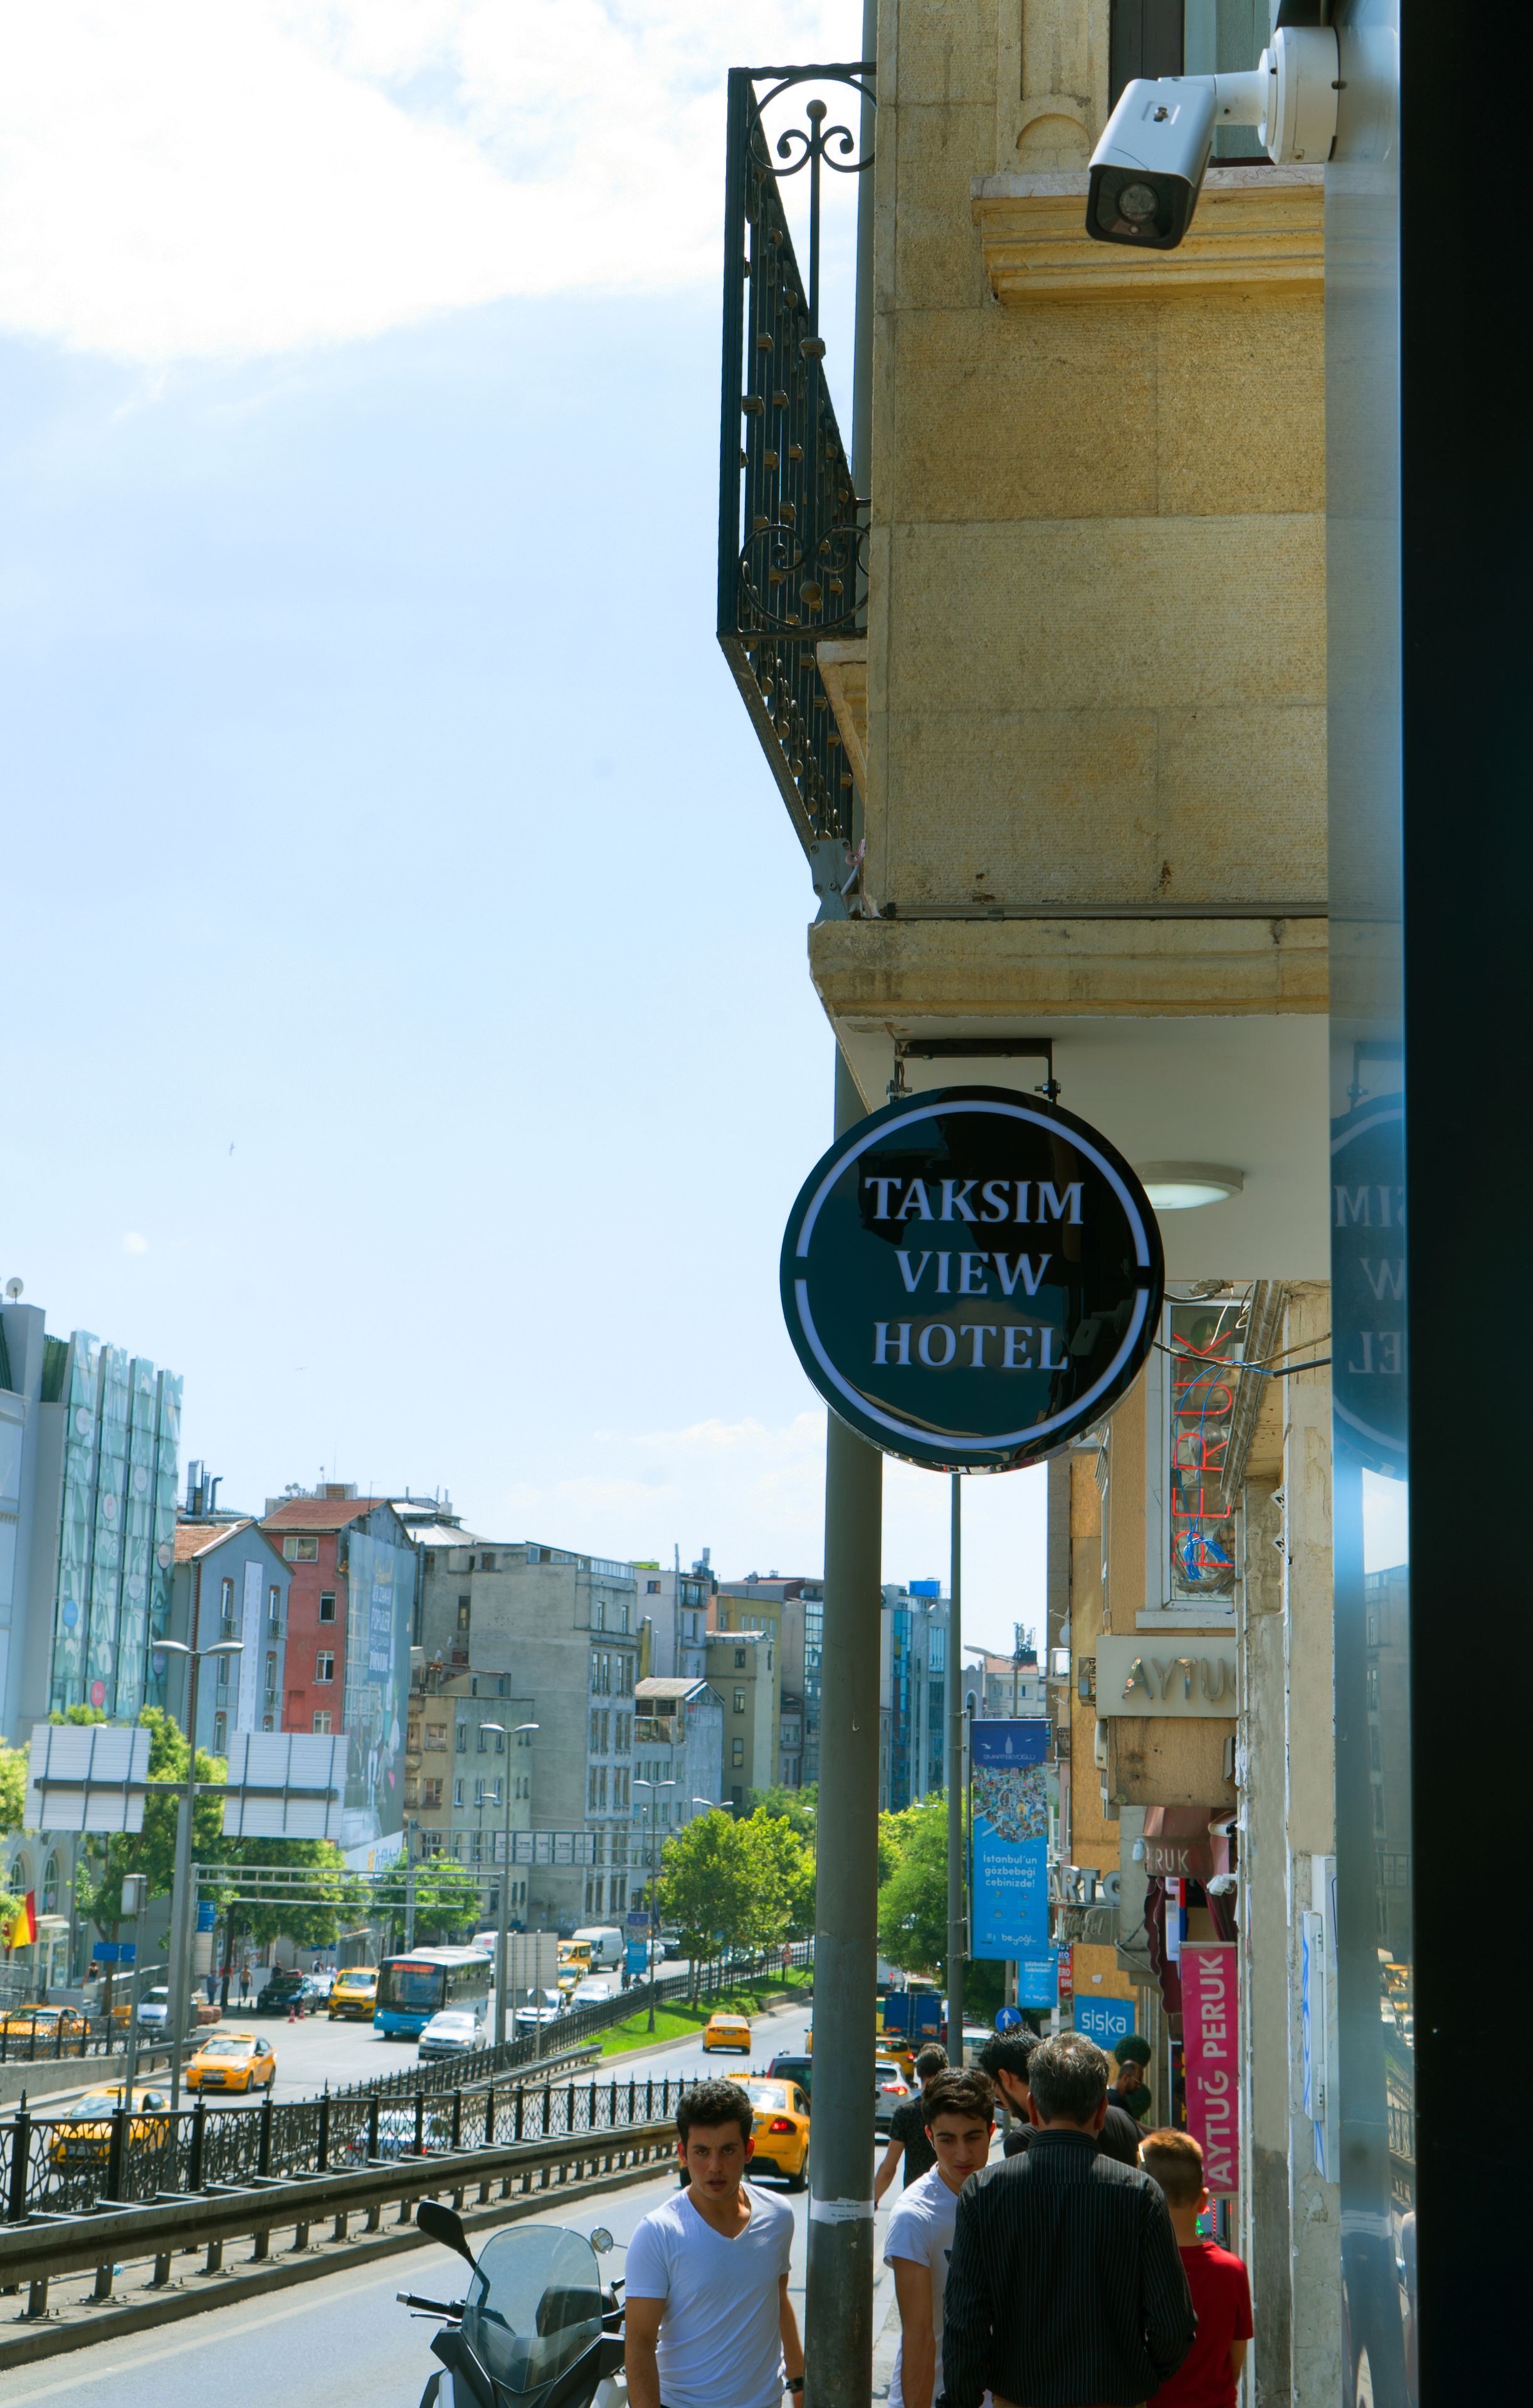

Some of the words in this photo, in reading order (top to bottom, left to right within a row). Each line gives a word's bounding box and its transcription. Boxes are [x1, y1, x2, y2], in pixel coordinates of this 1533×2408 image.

[865, 1177, 1085, 1225] TAKSIM
[893, 1250, 1053, 1296] VIEW
[872, 1321, 1068, 1370] HOTEL
[1122, 1657, 1236, 1701] AYTU
[984, 1865, 1036, 1879] gözbebeği
[986, 1877, 1035, 1888] cebinizde!
[1082, 2009, 1127, 2036] siska
[1198, 1954, 1228, 2058] PERUK
[1198, 2070, 1233, 2185] AYTUĞ
